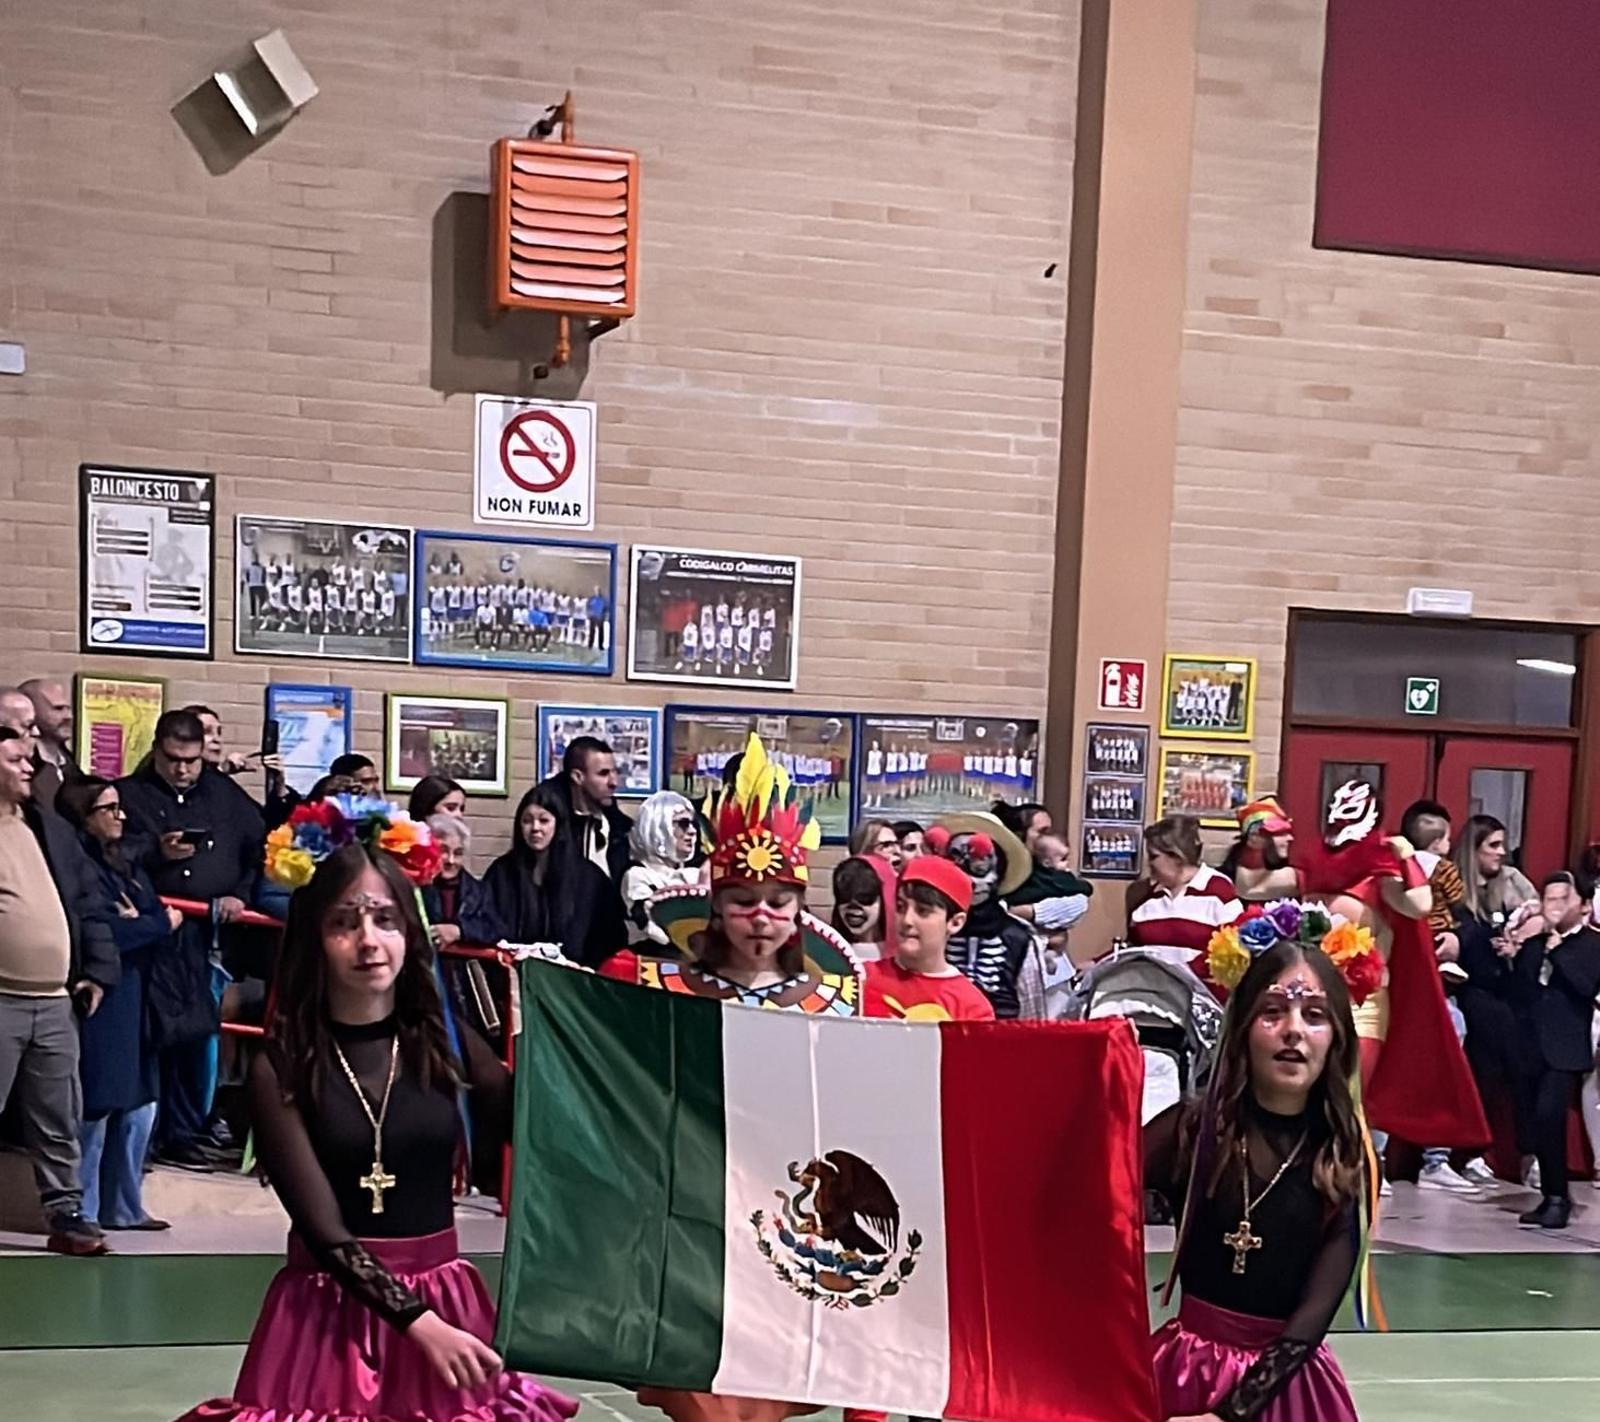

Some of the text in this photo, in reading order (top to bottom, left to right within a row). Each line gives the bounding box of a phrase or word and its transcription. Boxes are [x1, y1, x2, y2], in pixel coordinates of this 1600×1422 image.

[91, 477, 180, 500] BALONCESTO
[488, 496, 581, 516] NON FUMAR
